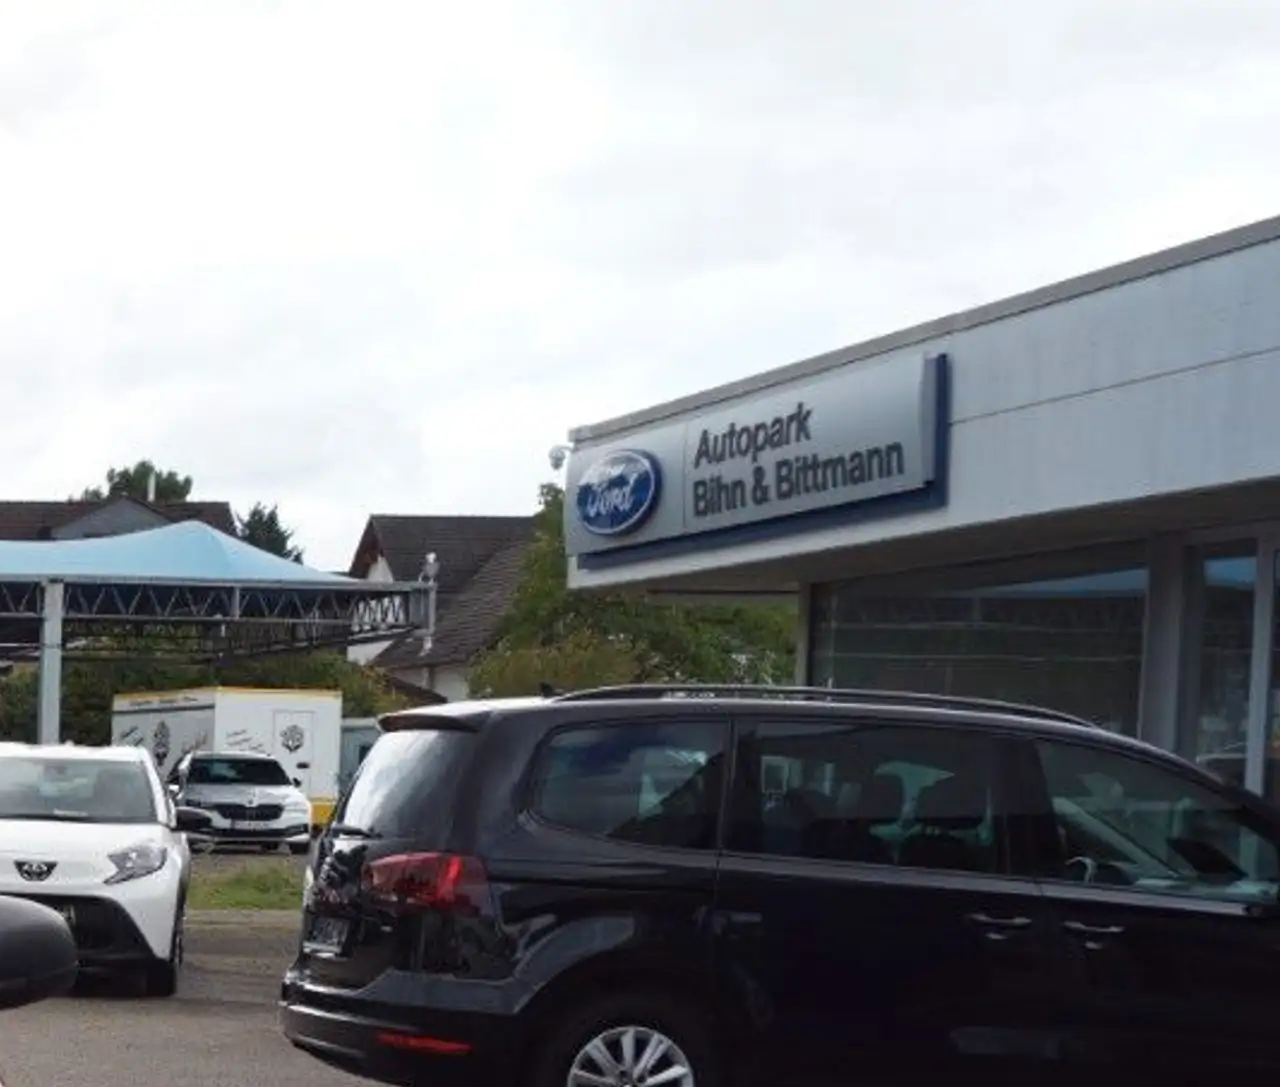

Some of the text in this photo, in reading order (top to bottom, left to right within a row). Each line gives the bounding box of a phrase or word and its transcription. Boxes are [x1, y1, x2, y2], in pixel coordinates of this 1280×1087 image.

[694, 402, 813, 470] Autopark
[586, 462, 640, 518] Ford
[693, 441, 905, 517] Bihn & Bittmann
